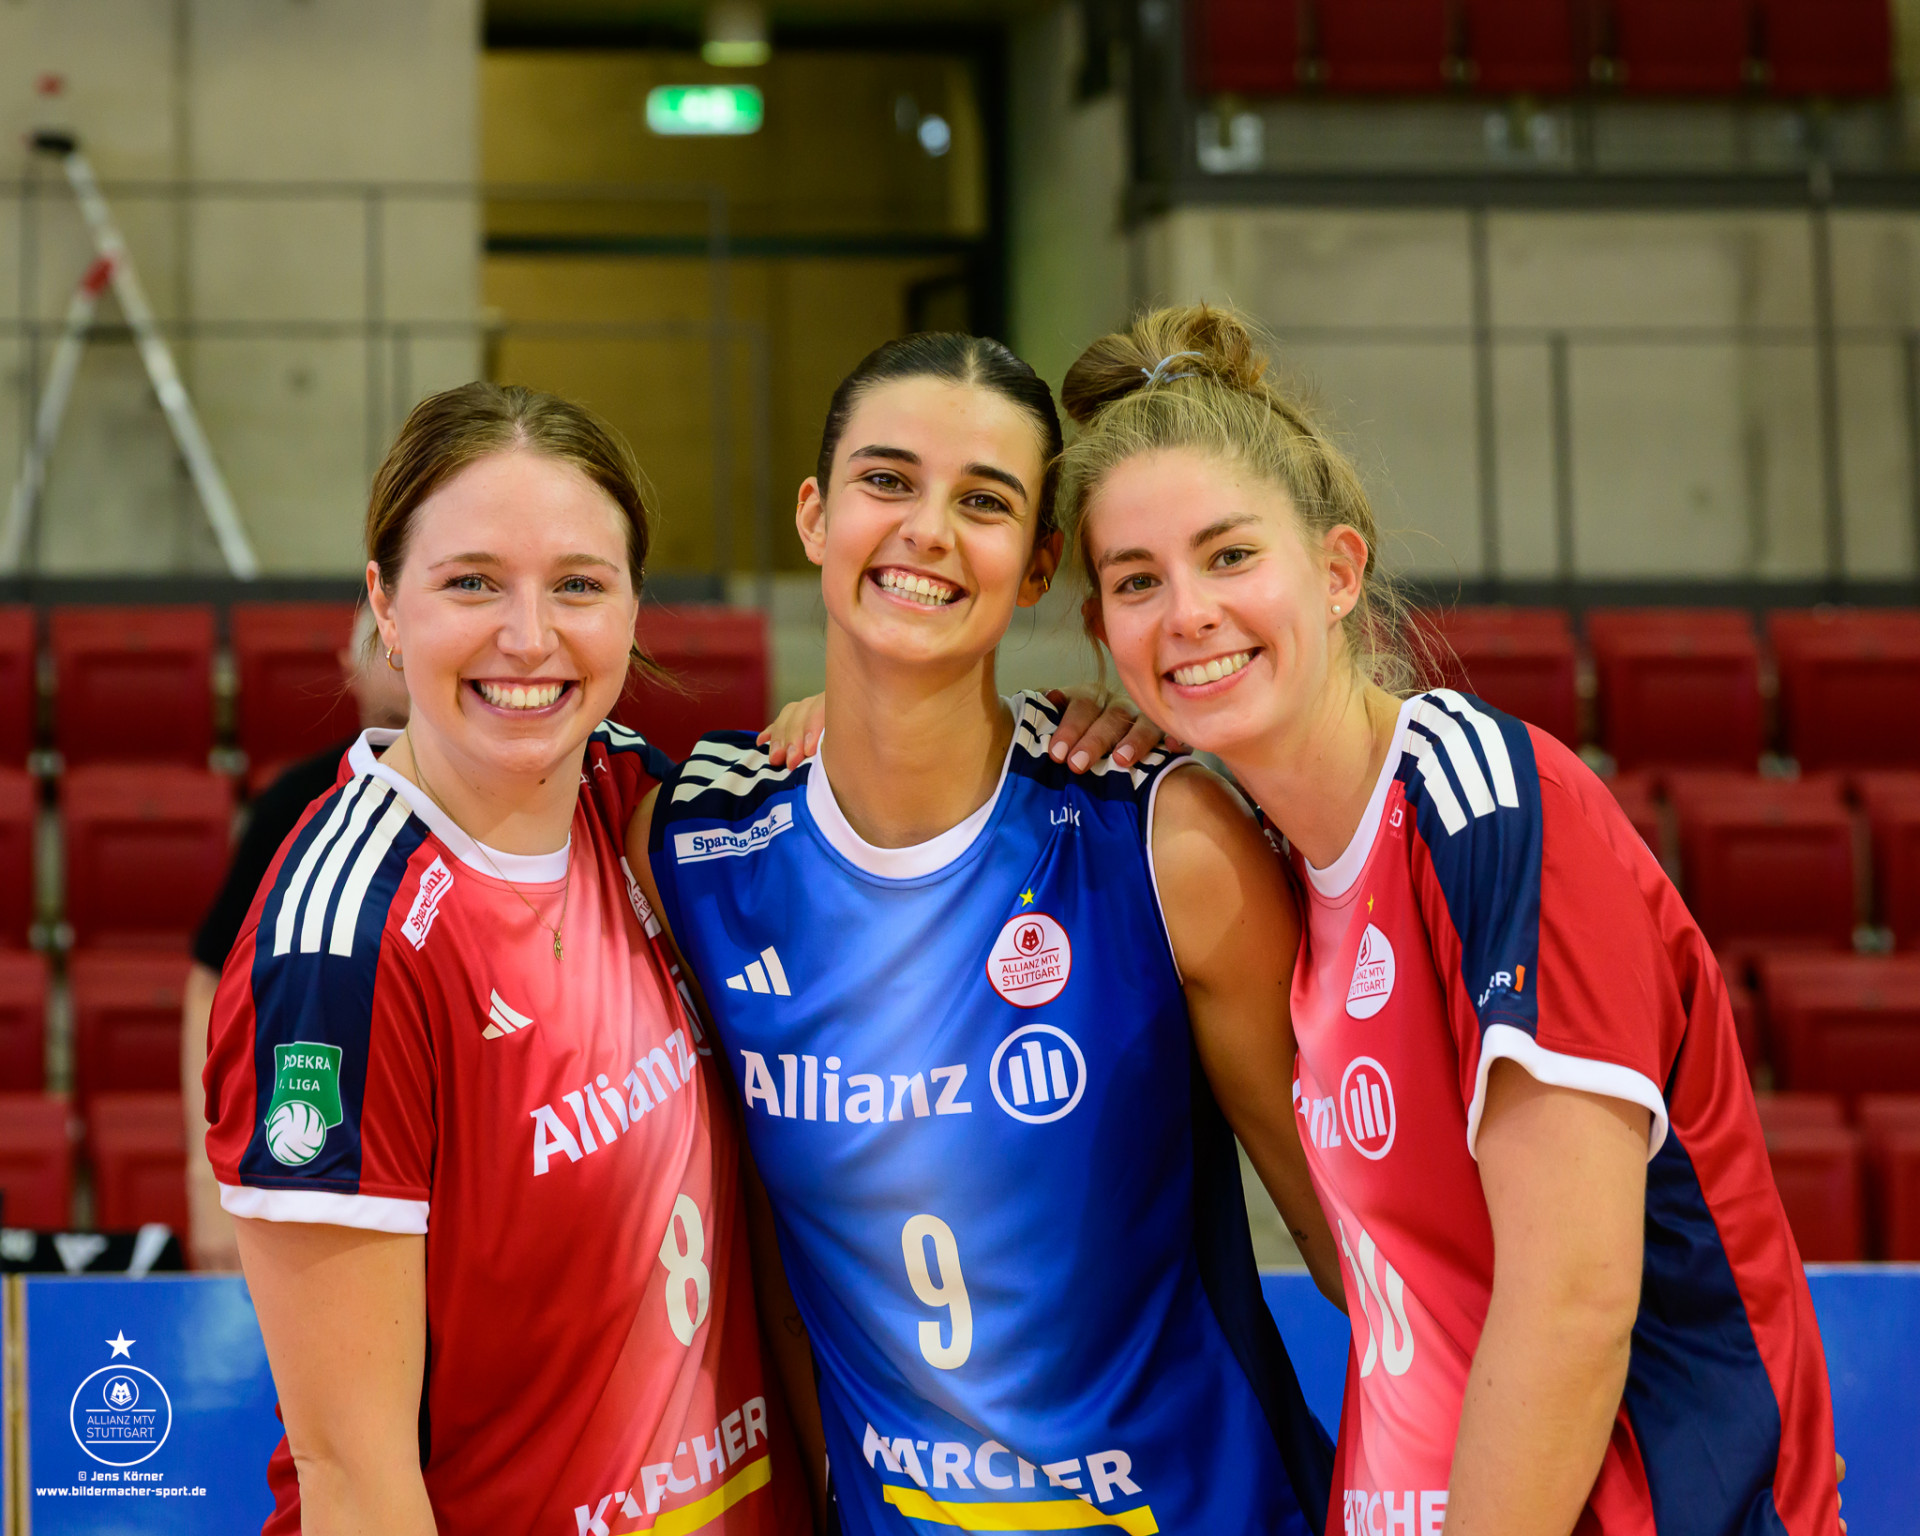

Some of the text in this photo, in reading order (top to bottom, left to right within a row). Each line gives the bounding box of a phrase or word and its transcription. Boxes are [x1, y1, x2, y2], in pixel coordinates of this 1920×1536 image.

[1002, 953, 1059, 974] ALLIANZ MTV
[1369, 966, 1385, 977] MTV
[1002, 965, 1061, 987] STUTTGART
[1350, 978, 1386, 996] UTTGART
[288, 1078, 321, 1092] LIGA
[740, 1049, 973, 1124] Allianz
[530, 1027, 698, 1177] Allianz
[657, 1193, 711, 1347] 8
[901, 1213, 973, 1370] 9
